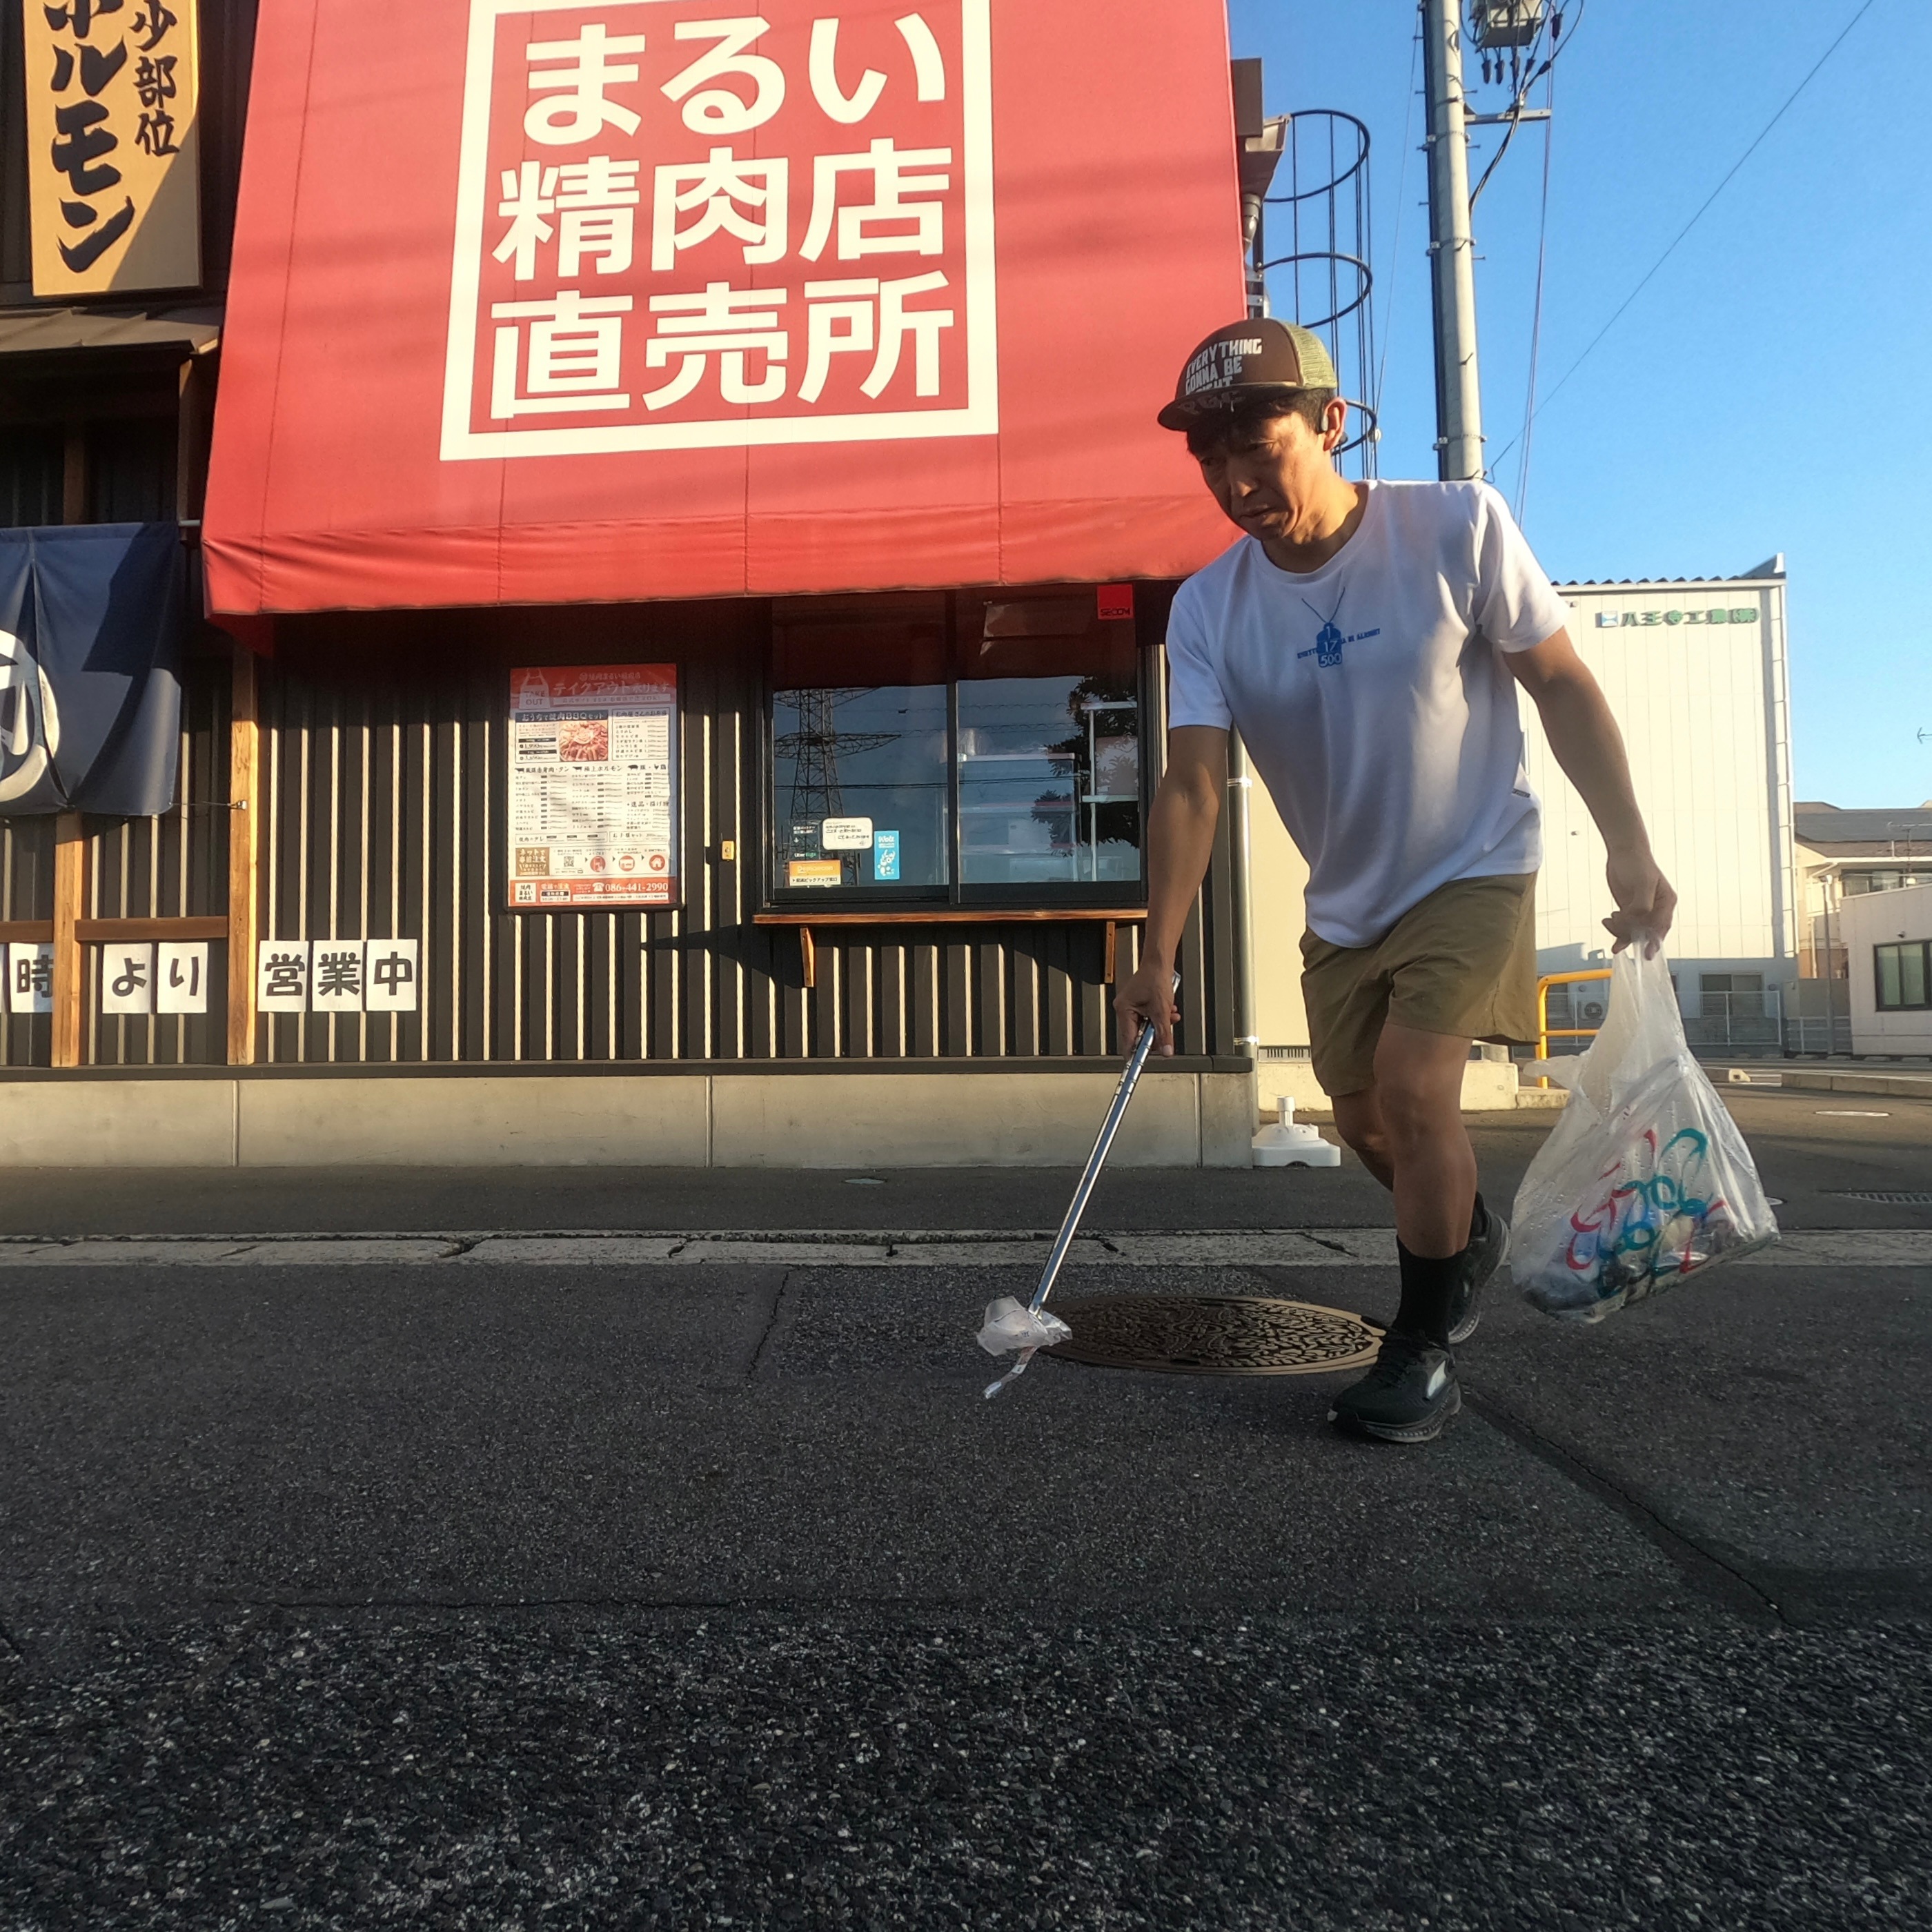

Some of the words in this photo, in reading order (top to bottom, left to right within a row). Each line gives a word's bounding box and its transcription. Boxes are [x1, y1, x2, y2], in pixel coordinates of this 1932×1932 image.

[129, 0, 180, 157] 少部位
[523, 12, 946, 145] まるい
[491, 137, 952, 281] 精肉店
[490, 270, 954, 420] 直売所
[1185, 338, 1263, 379] EVERYTHING
[1185, 364, 1219, 396] GONNA
[1223, 355, 1243, 376] BE
[1319, 653, 1342, 667] 500
[1324, 640, 1338, 653] 17
[605, 883, 669, 891] 086-441-2990
[112, 956, 199, 997] より
[264, 951, 413, 996] 営業中
